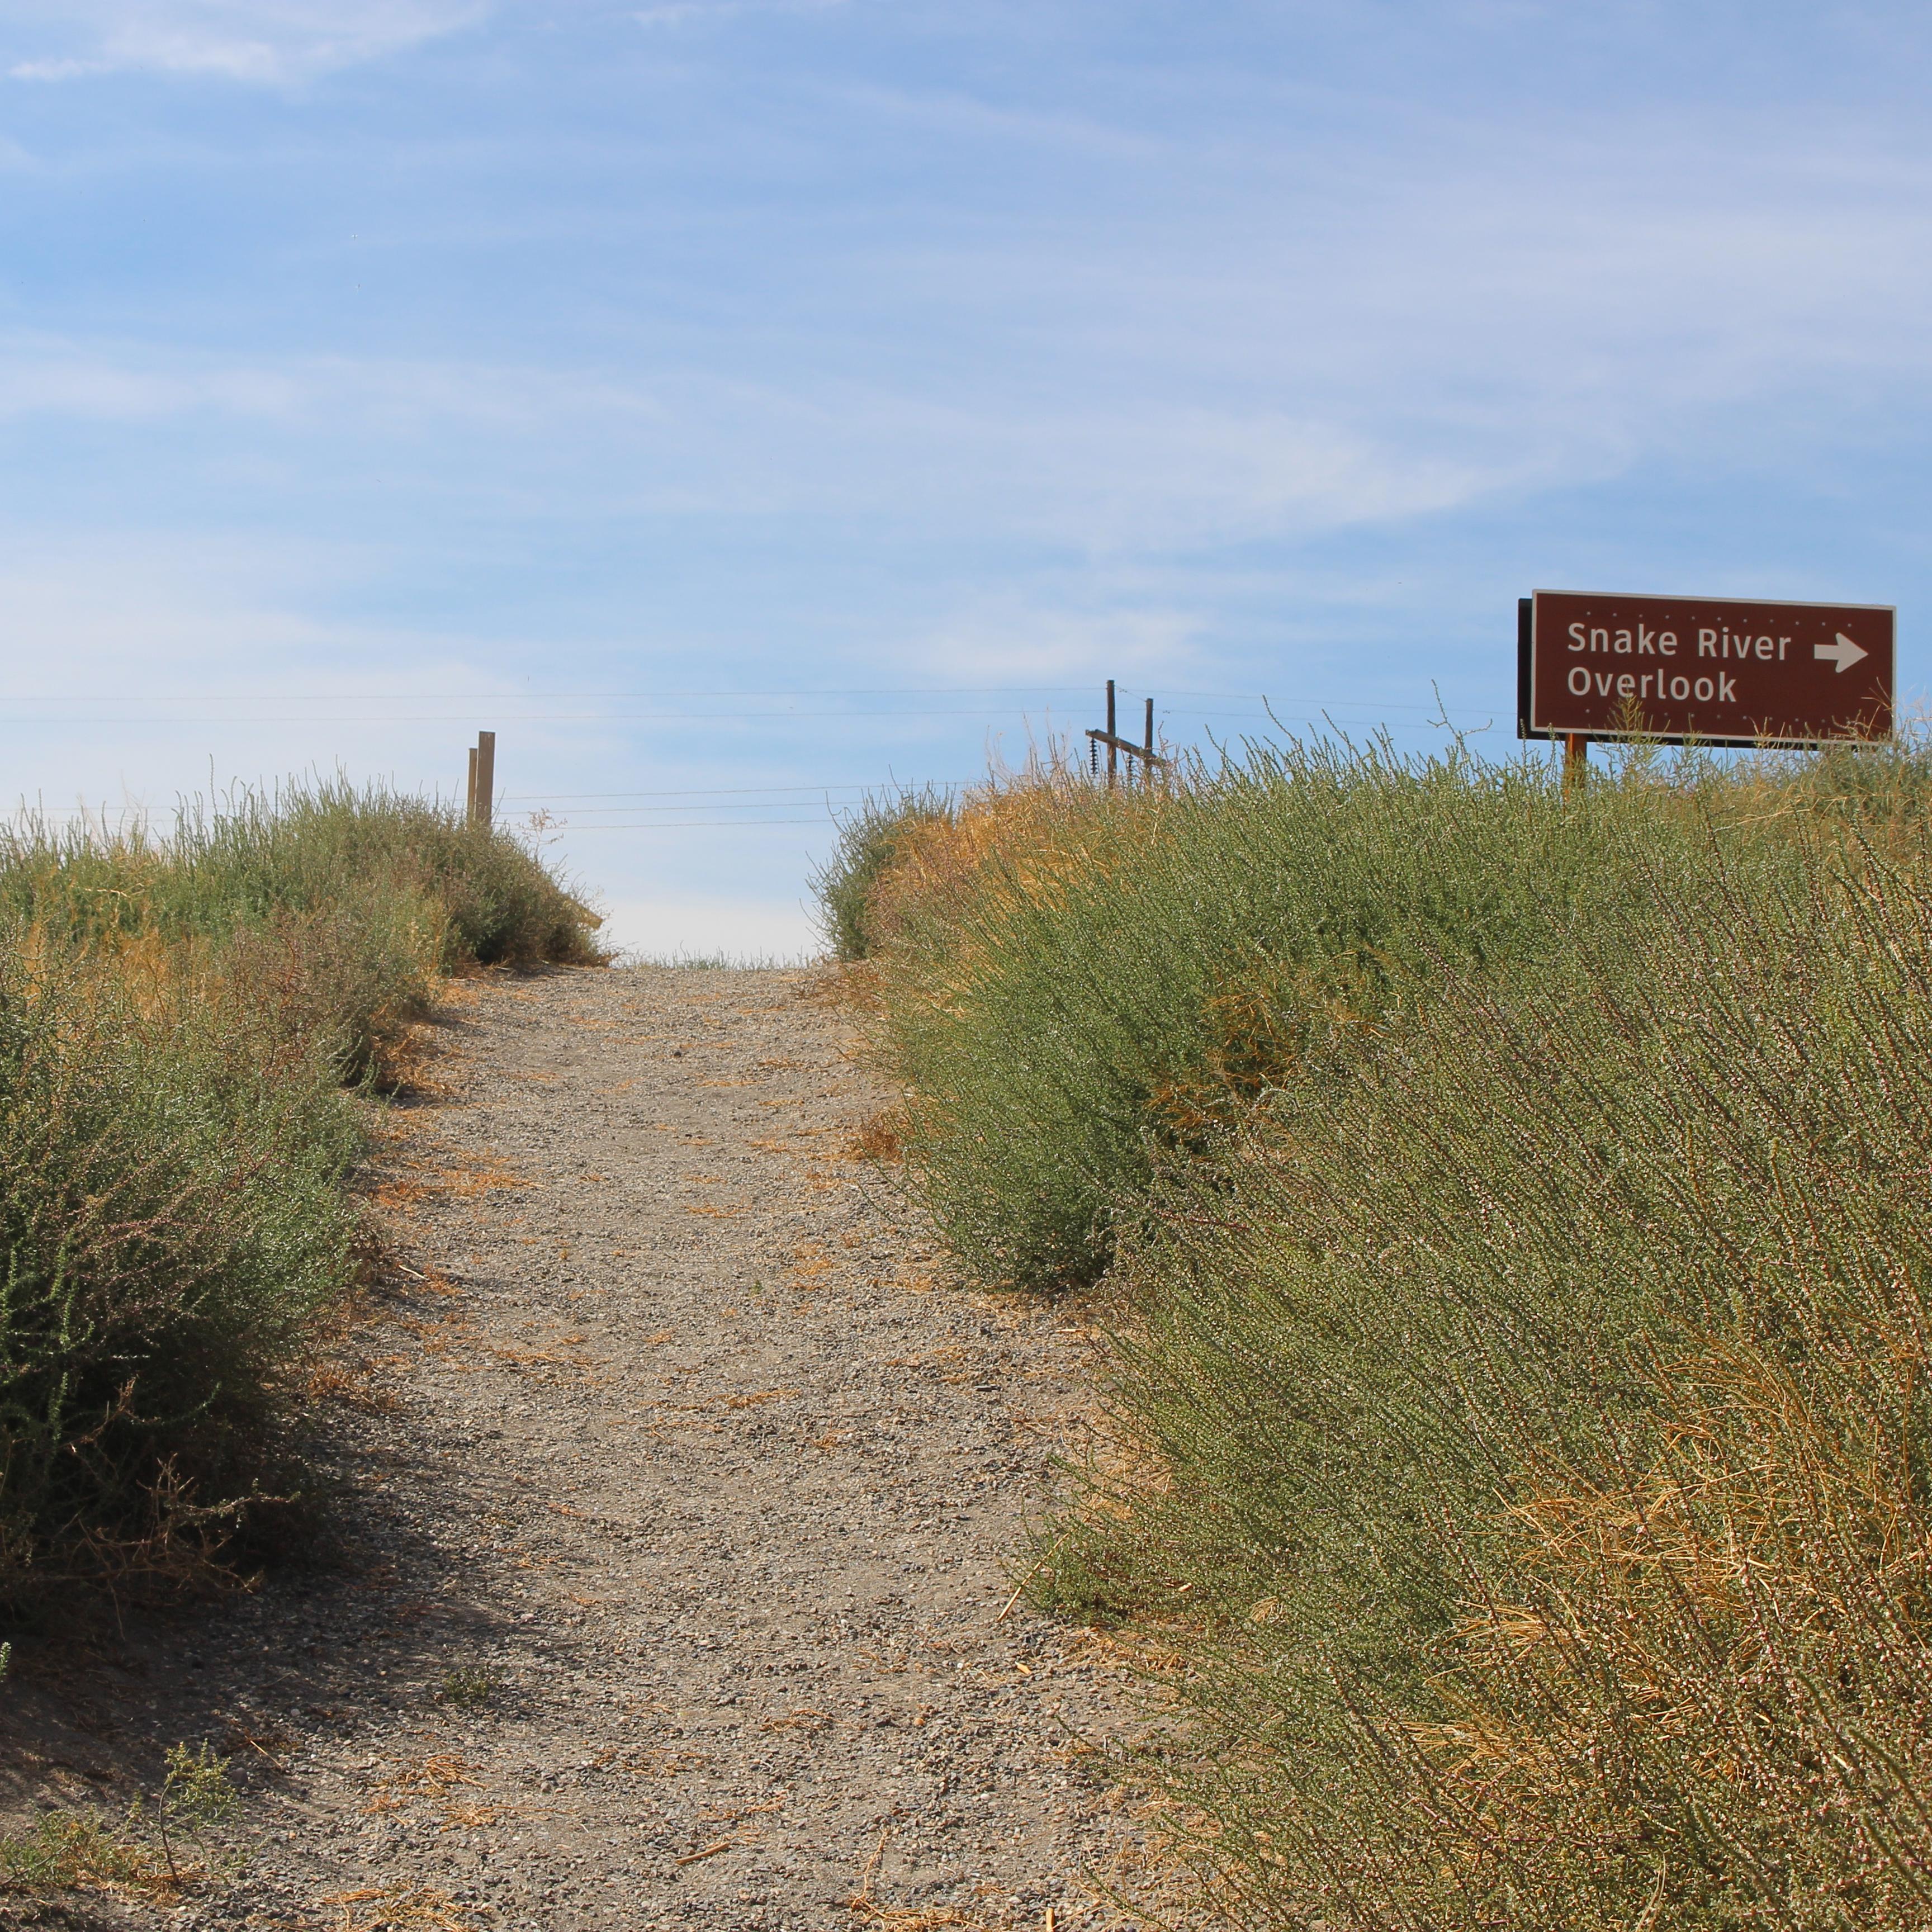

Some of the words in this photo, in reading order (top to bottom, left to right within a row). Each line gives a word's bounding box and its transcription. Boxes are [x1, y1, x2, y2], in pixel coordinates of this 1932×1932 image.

[1568, 623, 1677, 655] Snake
[1698, 627, 1791, 660] River
[1568, 666, 1737, 702] Overlook
